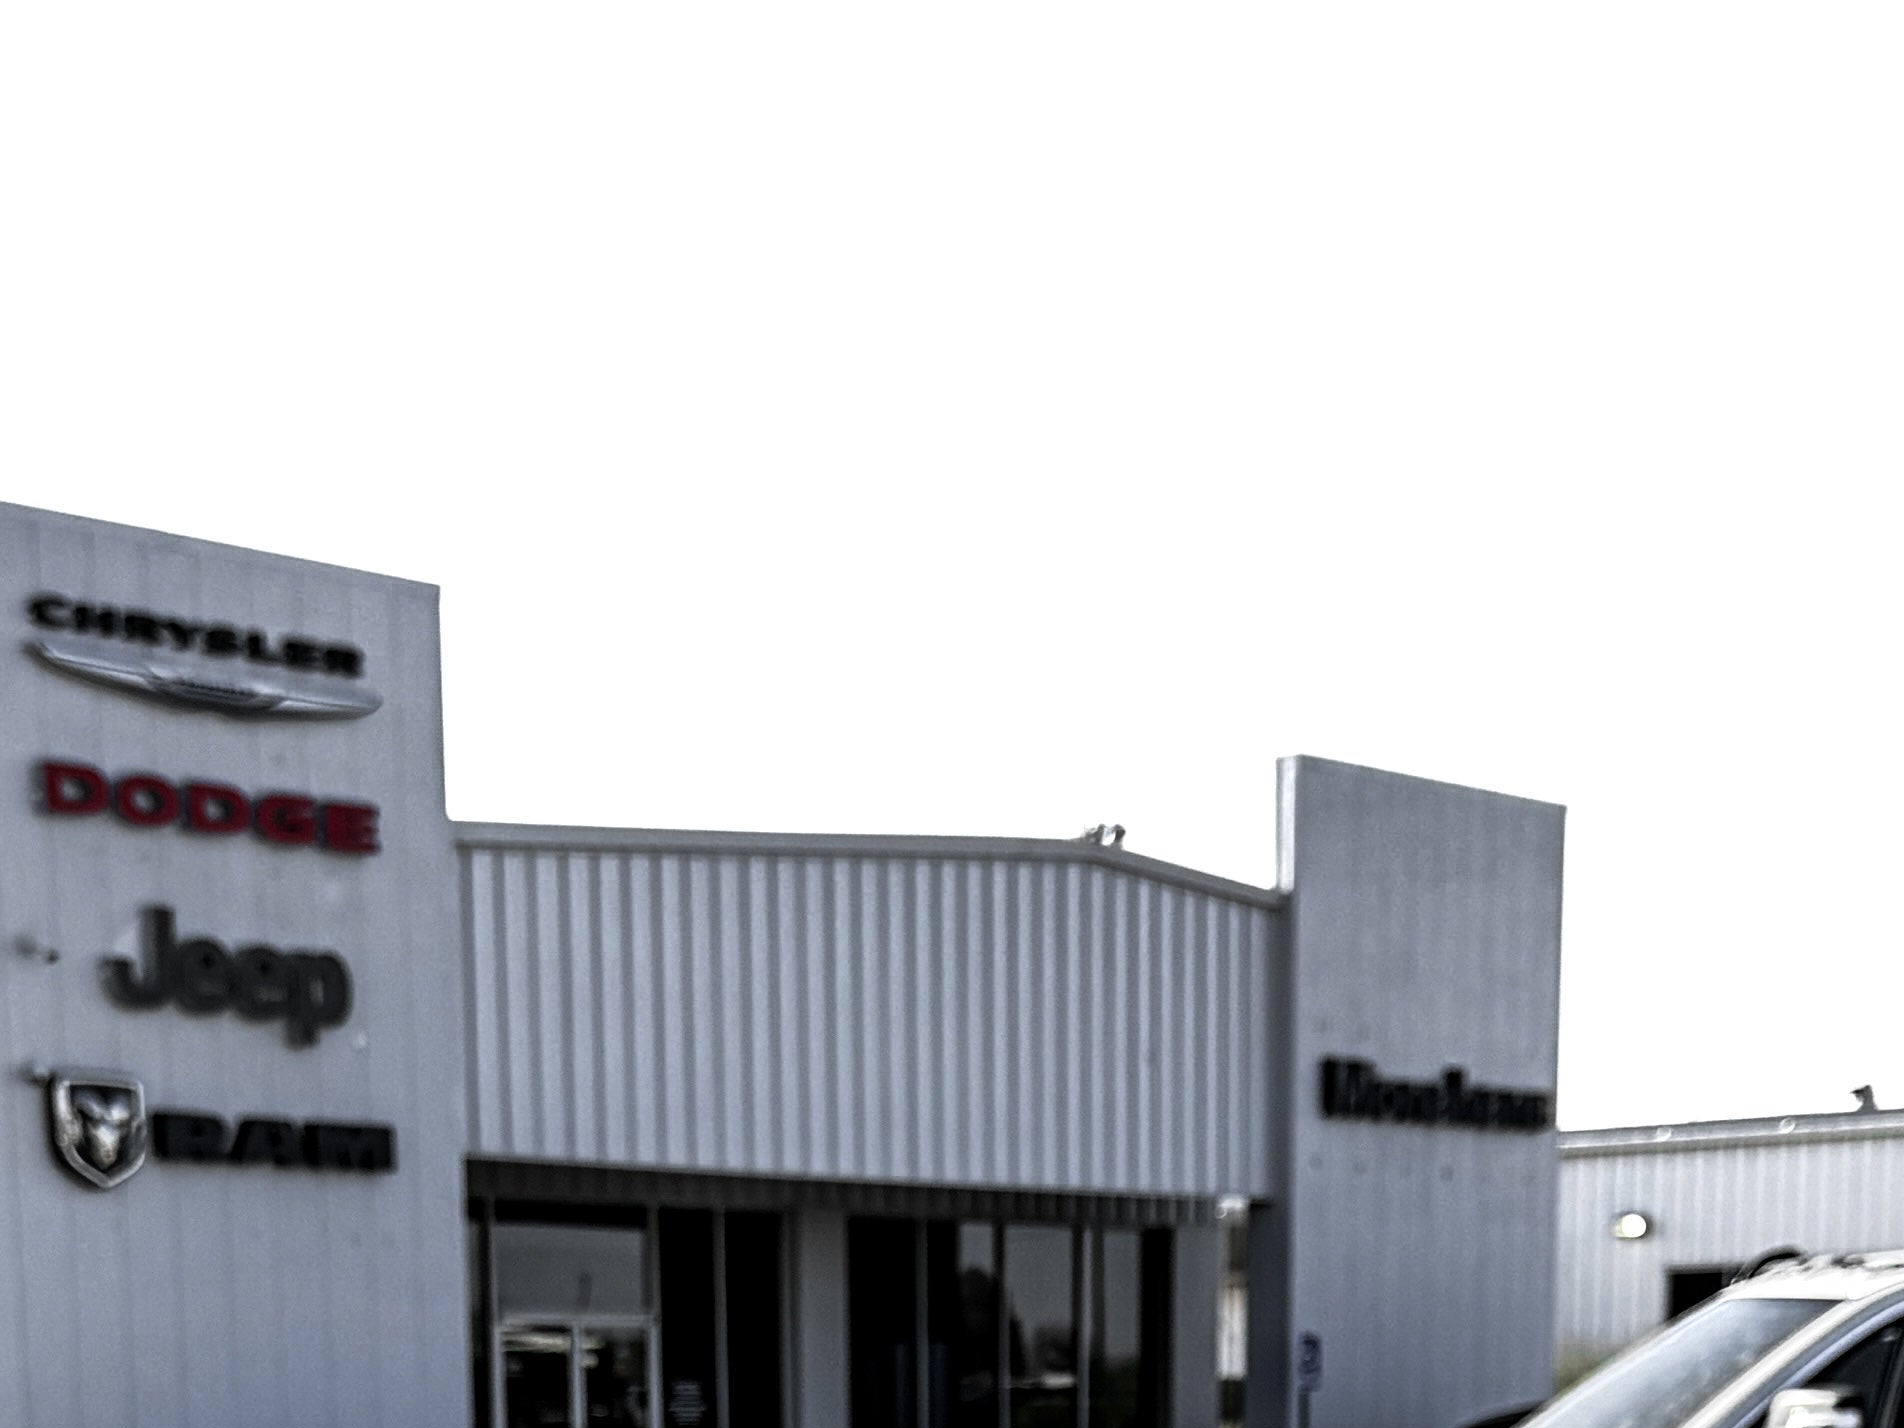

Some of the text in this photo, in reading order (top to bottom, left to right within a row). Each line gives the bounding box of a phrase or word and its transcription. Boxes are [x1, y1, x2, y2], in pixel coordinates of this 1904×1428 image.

[27, 596, 365, 678] CHRYSLER
[34, 759, 381, 855] DODGE
[100, 904, 352, 1050] Jeep
[152, 1112, 395, 1174] RAM
